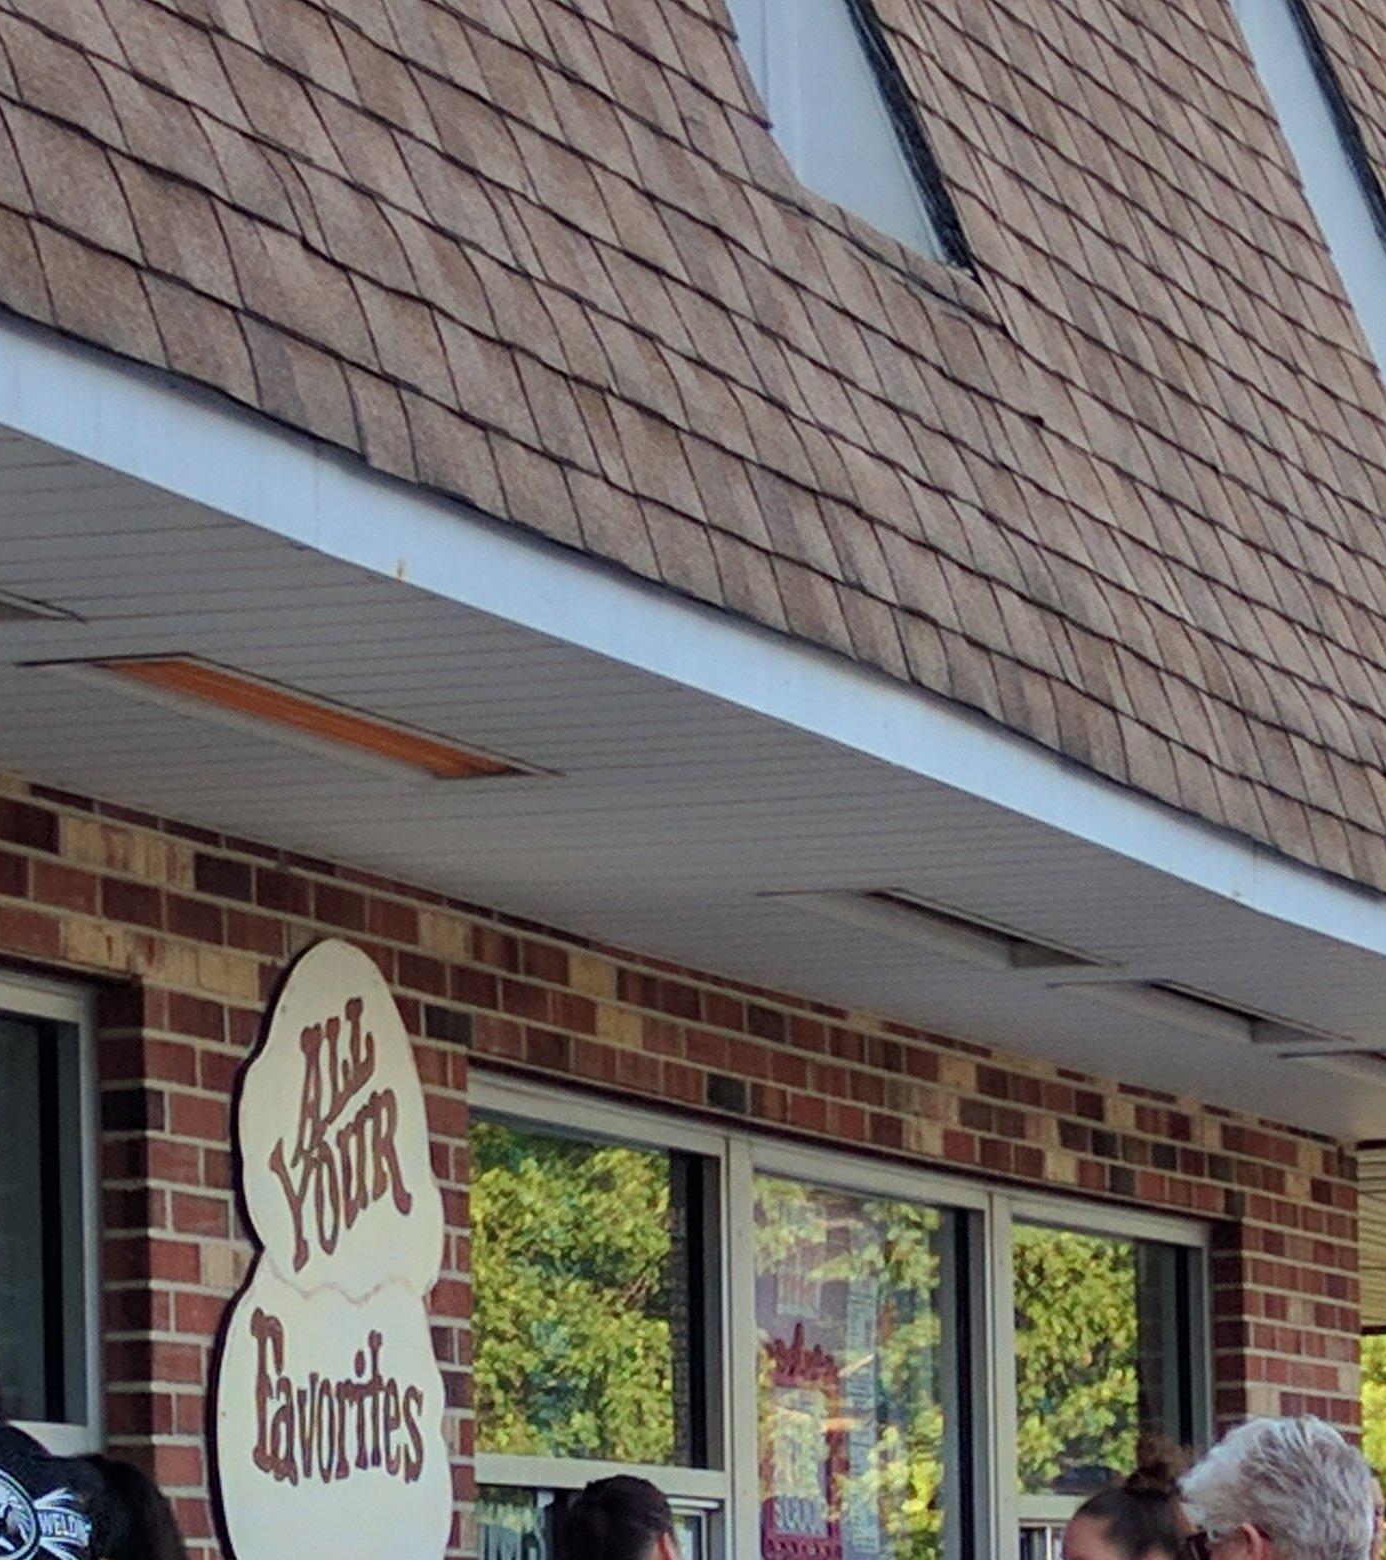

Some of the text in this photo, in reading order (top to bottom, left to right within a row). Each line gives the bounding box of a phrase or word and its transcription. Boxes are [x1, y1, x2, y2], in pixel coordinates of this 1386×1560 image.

[293, 996, 376, 1167] ALL
[270, 1088, 413, 1273] YOUR
[250, 1306, 424, 1487] Favorites
